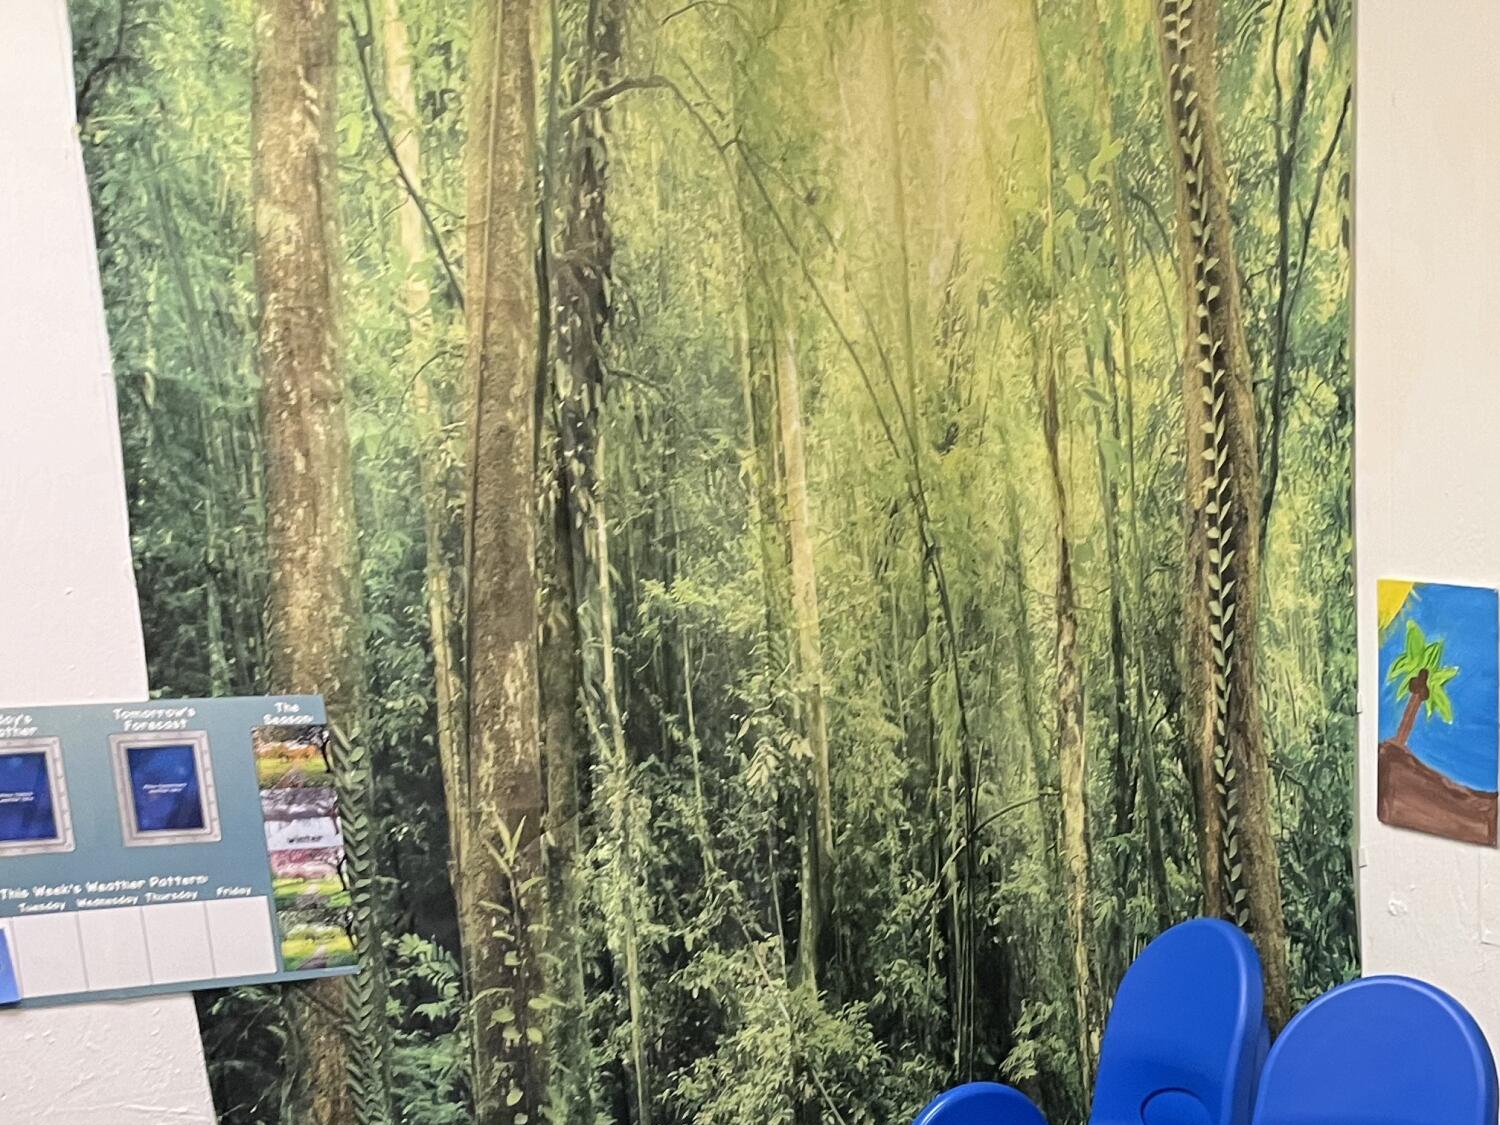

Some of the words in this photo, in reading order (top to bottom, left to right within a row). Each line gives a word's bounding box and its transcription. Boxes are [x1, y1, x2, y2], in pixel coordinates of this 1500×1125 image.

[112, 707, 197, 720] Tomorrow's
[273, 702, 300, 713] The
[123, 719, 190, 732] Forecast
[0, 887, 30, 899] This
[33, 883, 82, 898] Week's
[86, 878, 146, 893] Weather
[18, 901, 66, 913] Tuesday
[75, 895, 138, 909] Wednesday
[144, 890, 199, 903] Thursday
[216, 886, 252, 898] Friday
